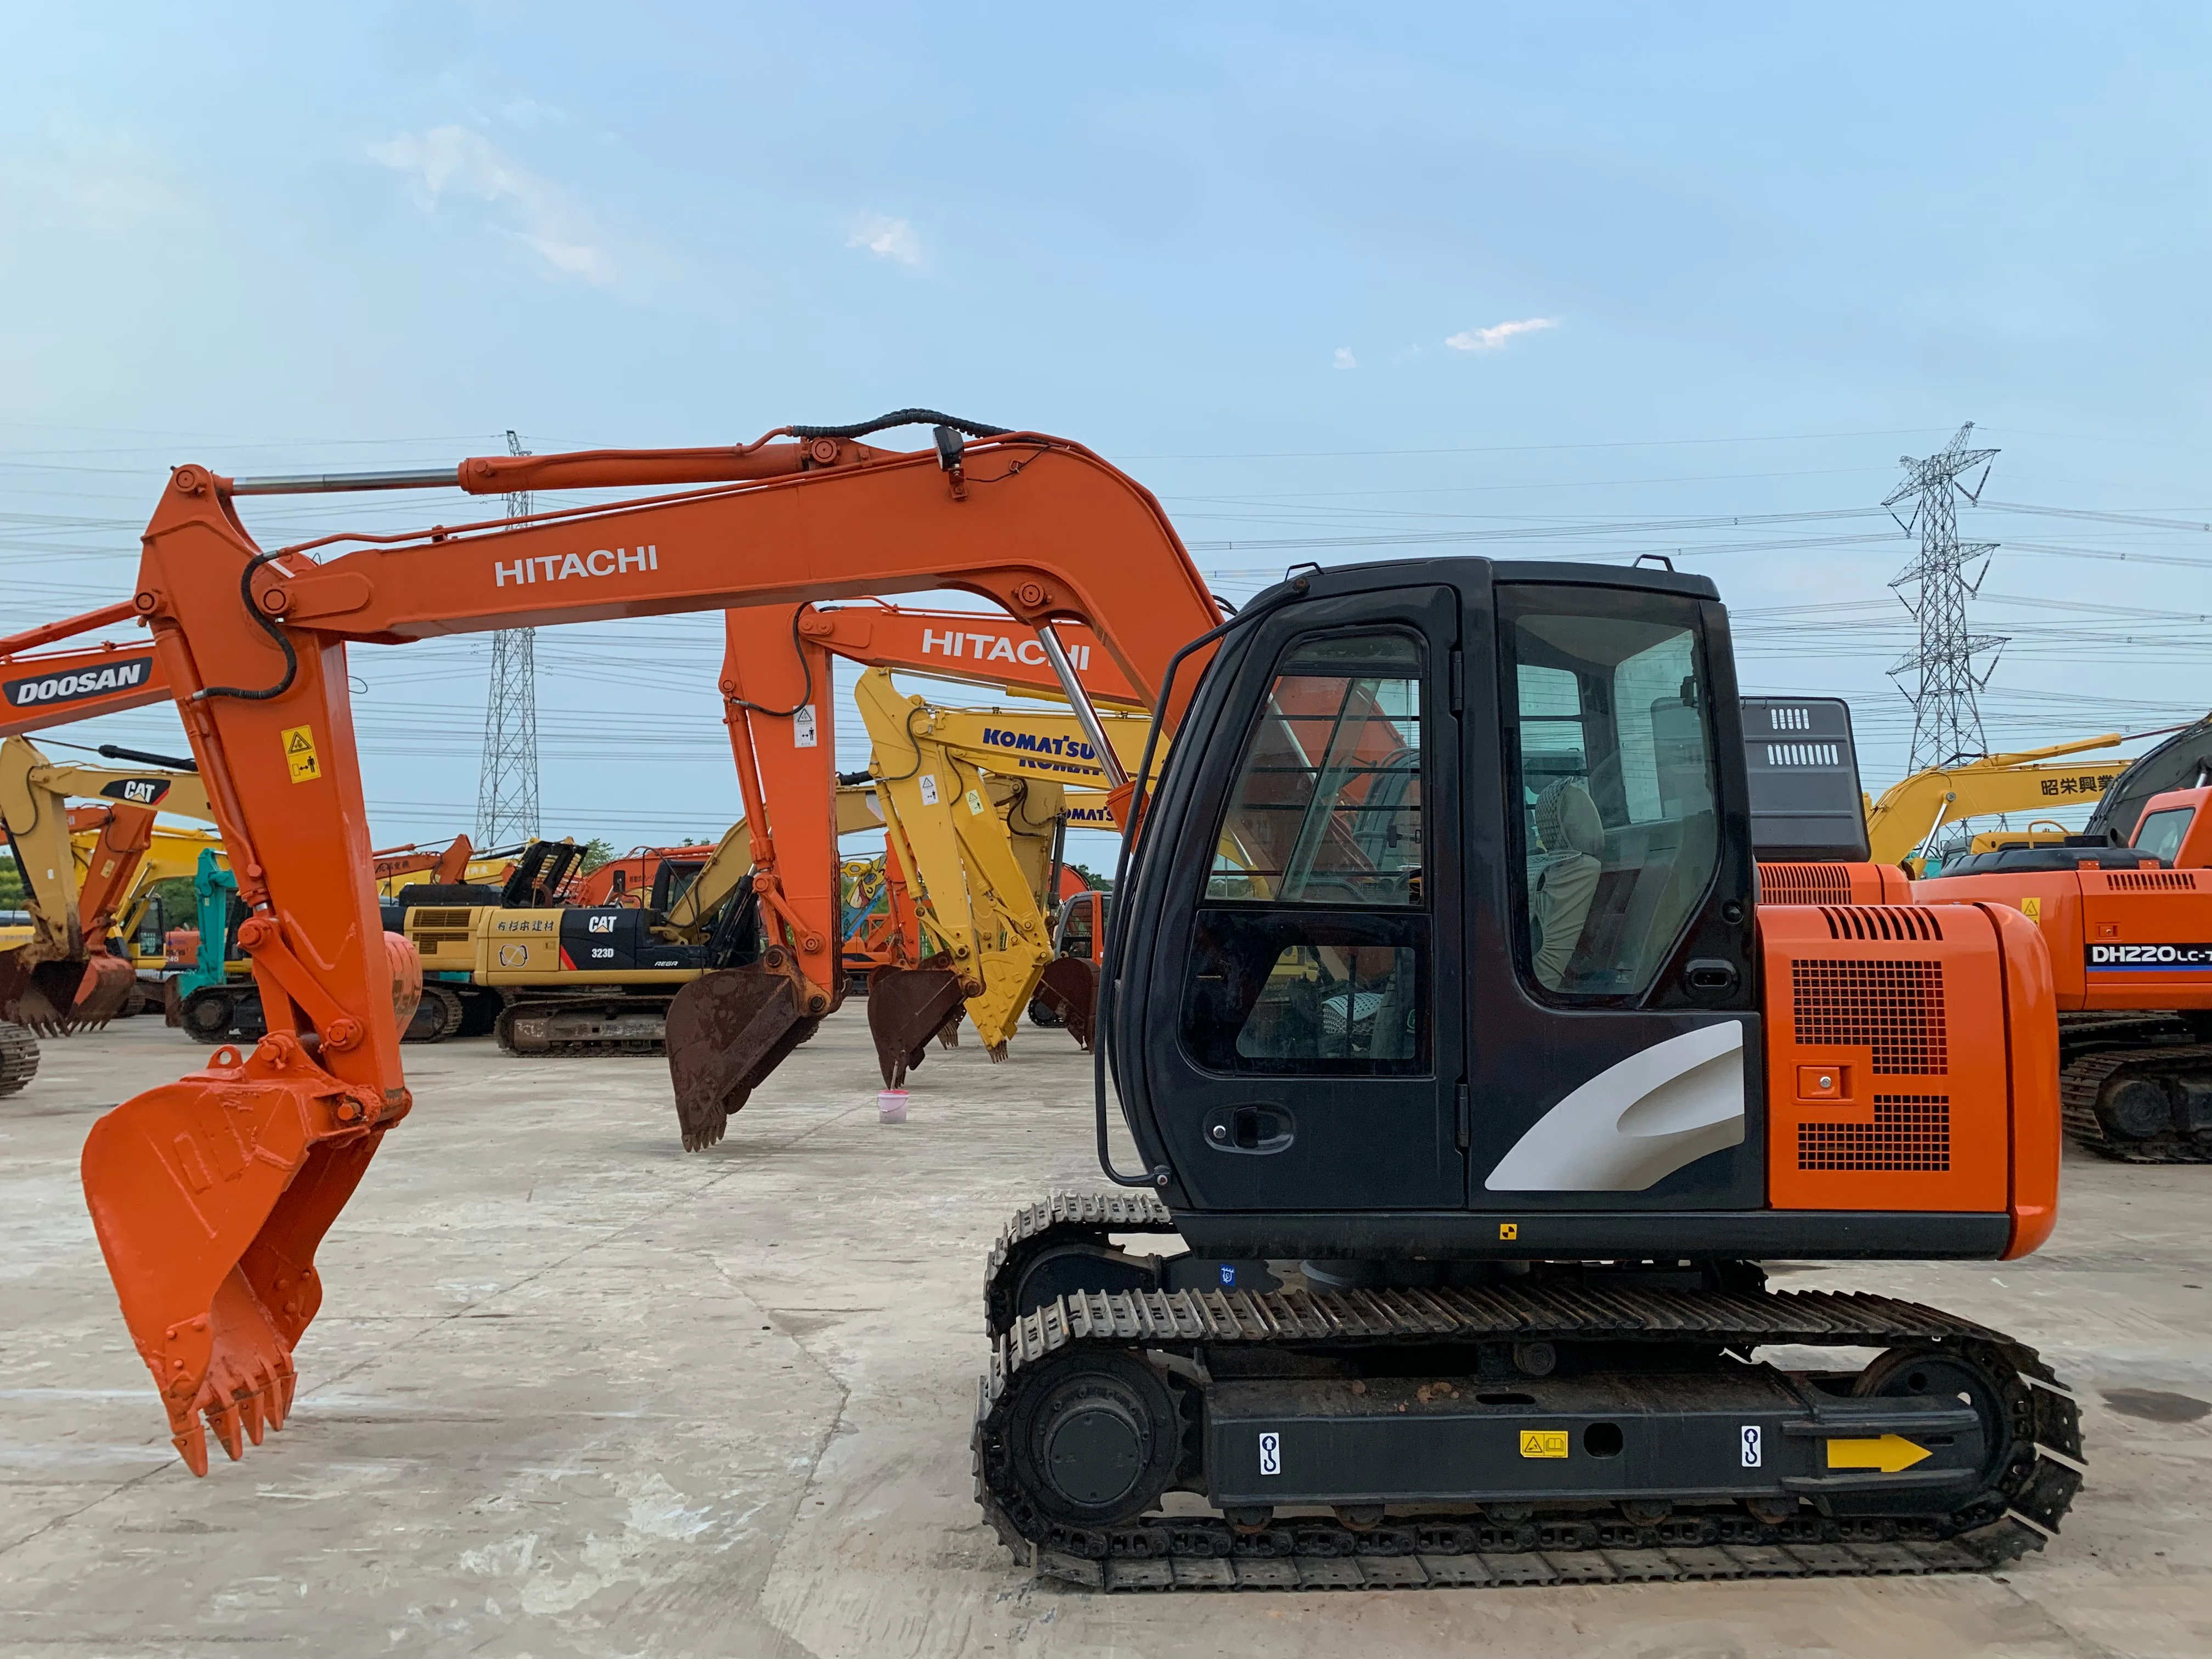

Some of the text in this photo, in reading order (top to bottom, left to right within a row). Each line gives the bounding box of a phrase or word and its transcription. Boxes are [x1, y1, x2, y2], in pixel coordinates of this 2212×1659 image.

[495, 545, 658, 586] HITACHI
[16, 664, 141, 704] DOOSAN
[983, 728, 1096, 760] KOMATSU
[124, 781, 155, 803] CAT
[2041, 774, 2120, 795] 昭栄興業
[1066, 806, 1114, 822] MATS
[589, 916, 617, 933] CAT
[591, 948, 613, 958] 323D
